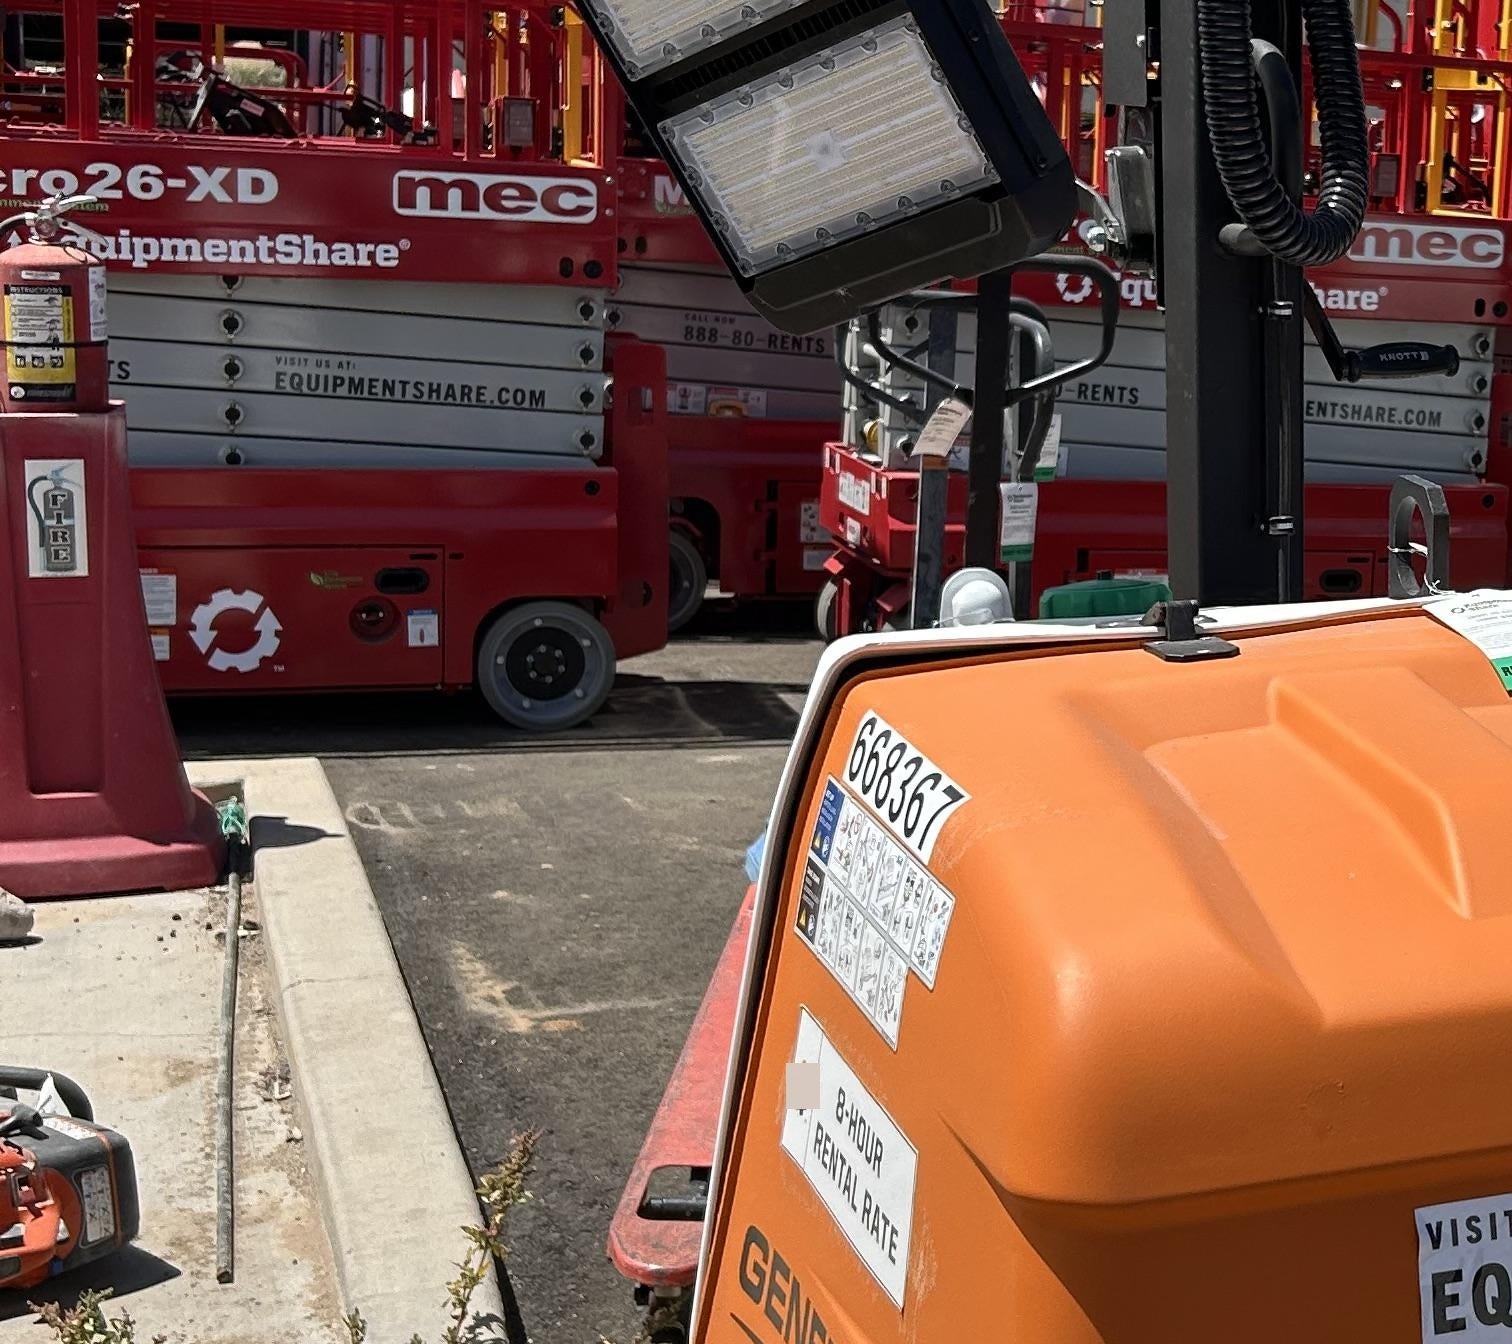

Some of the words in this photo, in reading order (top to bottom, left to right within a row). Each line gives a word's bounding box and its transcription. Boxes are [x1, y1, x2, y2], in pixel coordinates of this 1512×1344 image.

[0, 162, 279, 204] ro26-XD
[397, 176, 595, 216] mec
[684, 325, 825, 354] 888-80-RENTS
[274, 370, 547, 408] EQUIPMENTSHARE.COM
[48, 490, 71, 563] FIRE
[848, 716, 966, 851] 668367
[835, 1085, 884, 1179] 8-HOUR
[813, 1120, 858, 1213] RENTAL
[861, 1188, 899, 1266] RATE
